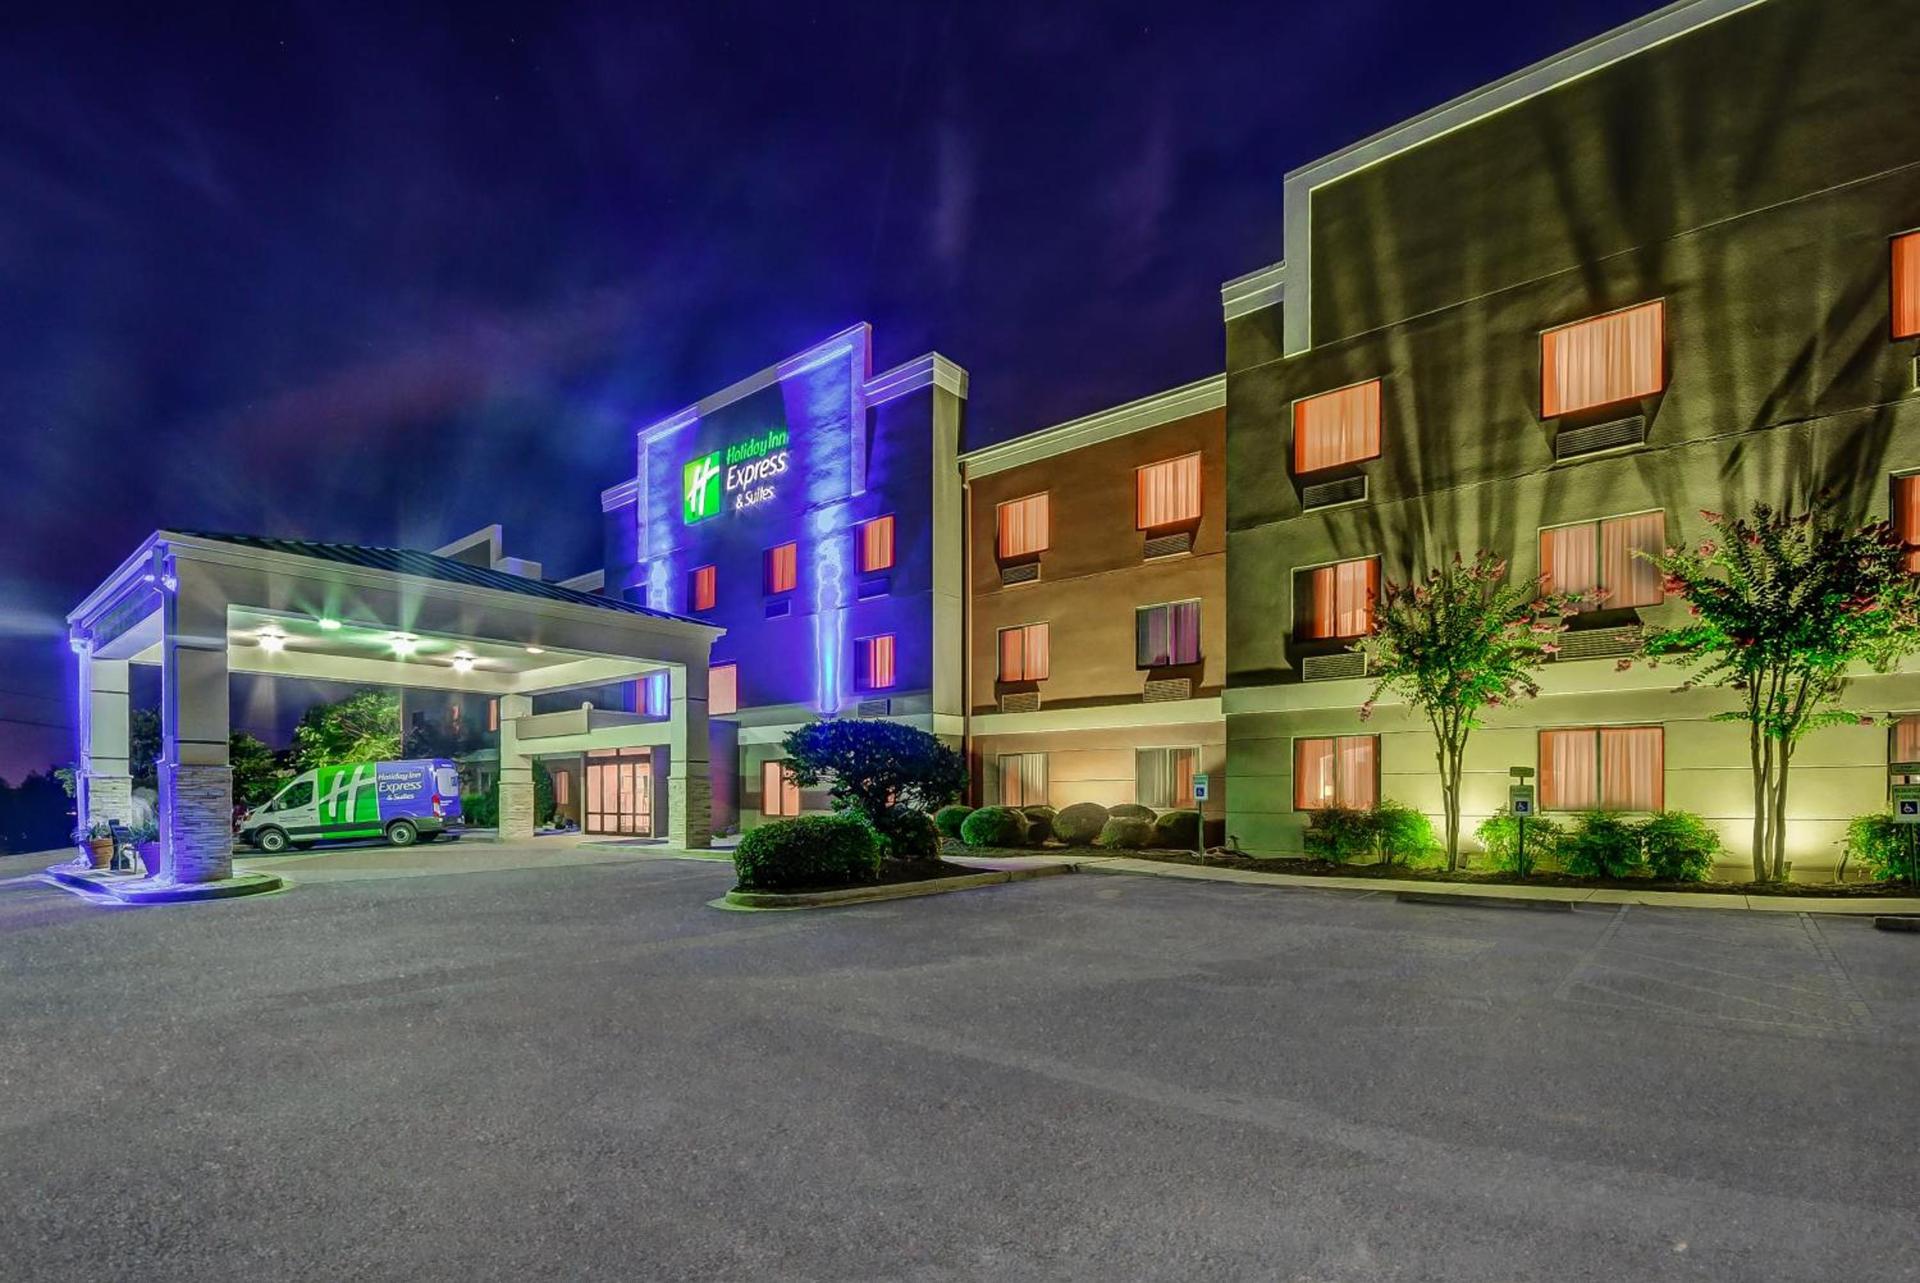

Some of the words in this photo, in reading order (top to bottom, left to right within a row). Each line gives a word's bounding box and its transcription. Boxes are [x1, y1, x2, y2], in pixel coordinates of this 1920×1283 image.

[726, 438, 767, 465] Holiday
[768, 431, 787, 449] Inn
[726, 452, 788, 491] Express
[744, 486, 776, 506] Suites
[378, 780, 422, 794] Express
